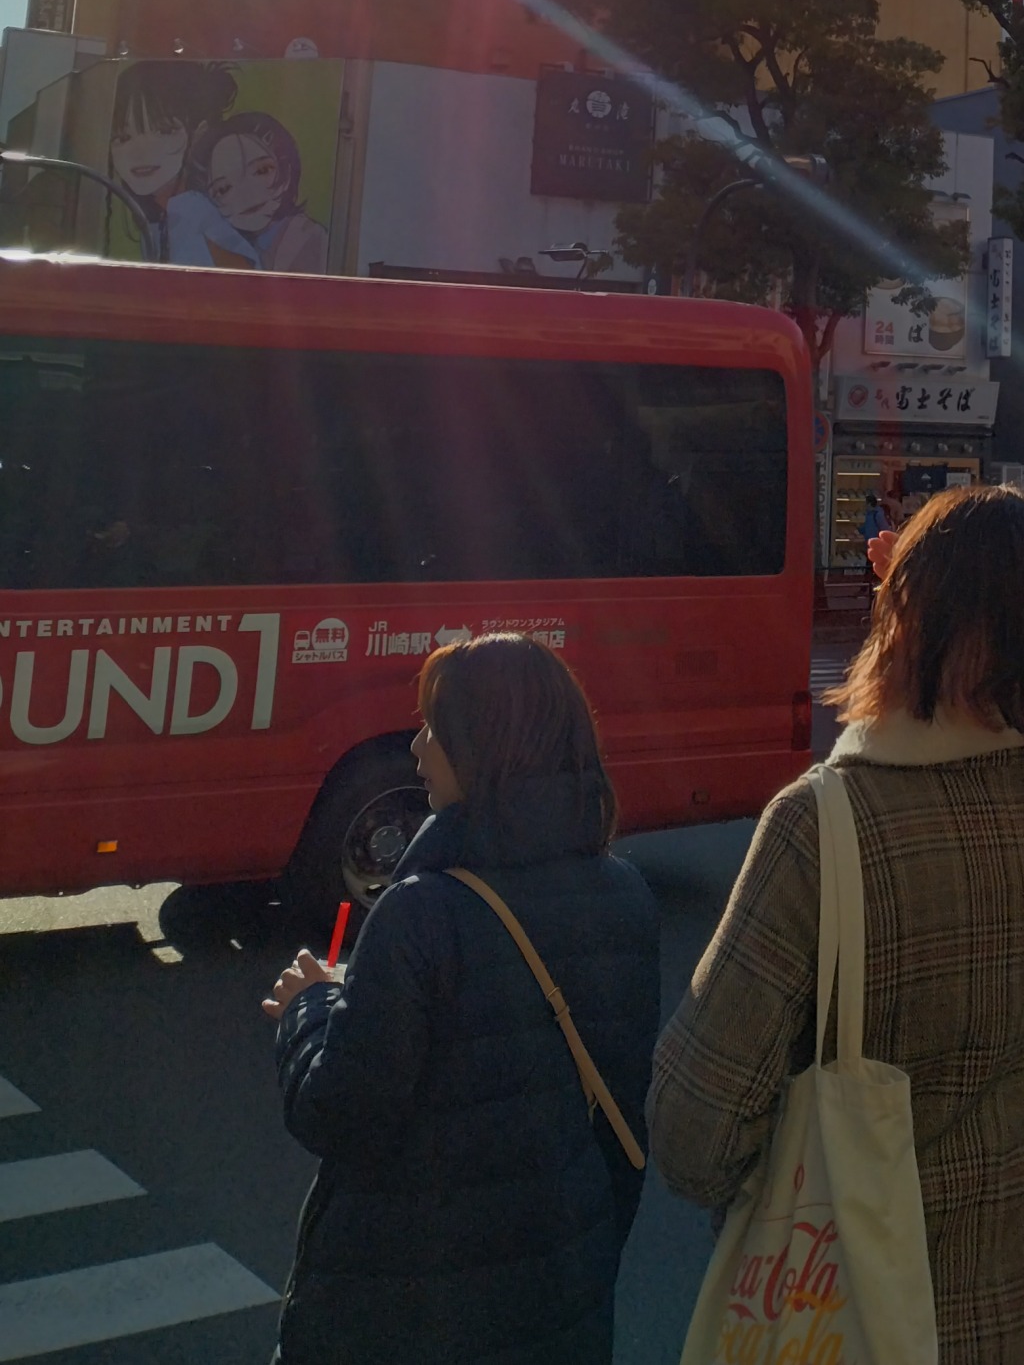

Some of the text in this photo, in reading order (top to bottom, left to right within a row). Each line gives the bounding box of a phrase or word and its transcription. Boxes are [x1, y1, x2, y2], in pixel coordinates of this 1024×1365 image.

[876, 321, 894, 334] 24
[368, 620, 388, 632] JR
[481, 618, 565, 630] ラウンドワンスタジアム
[314, 627, 346, 643] 無料
[365, 632, 432, 657] 川崎駅
[295, 650, 345, 662] シャトルバス
[0, 612, 281, 745] UND1
